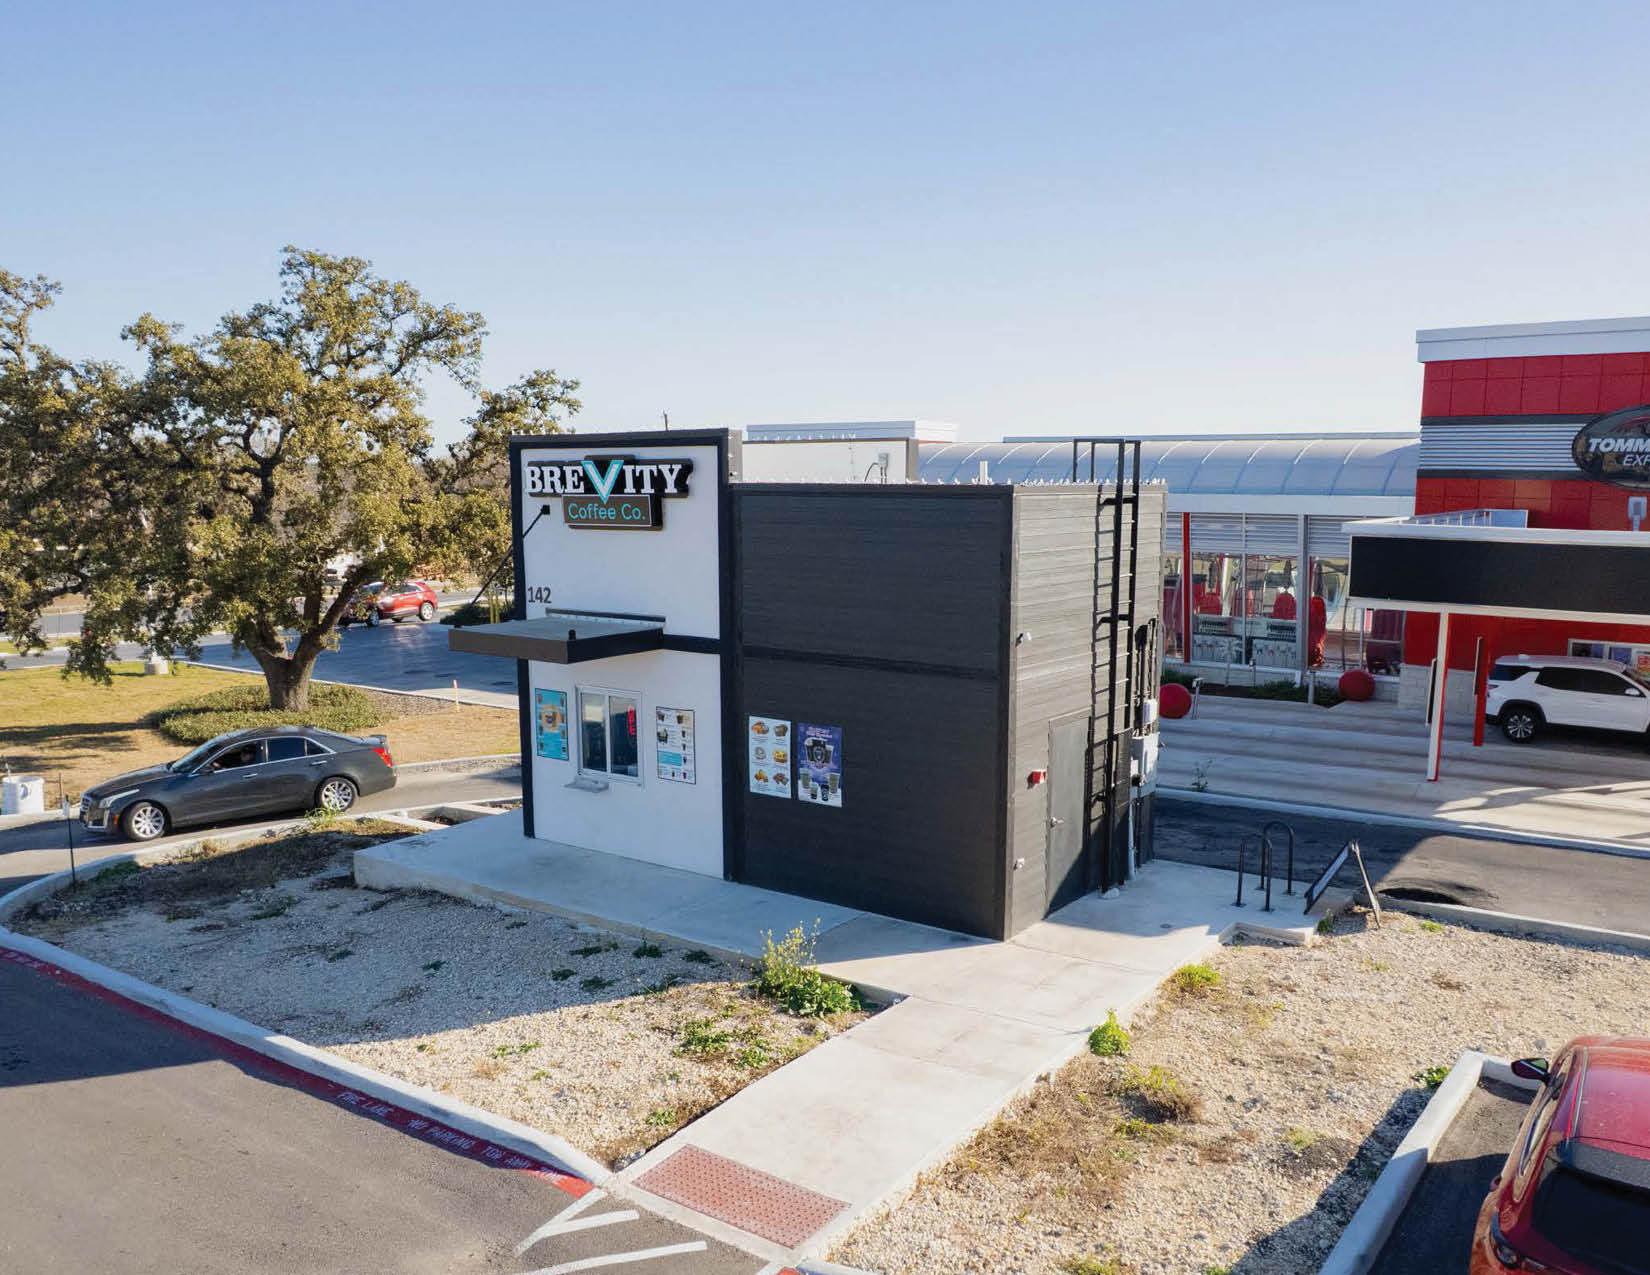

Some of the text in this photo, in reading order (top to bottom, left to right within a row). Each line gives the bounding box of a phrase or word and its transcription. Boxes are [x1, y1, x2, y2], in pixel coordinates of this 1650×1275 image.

[525, 460, 682, 504] BREVITY
[568, 503, 646, 520] Coffee Co.
[527, 586, 551, 604] 142
